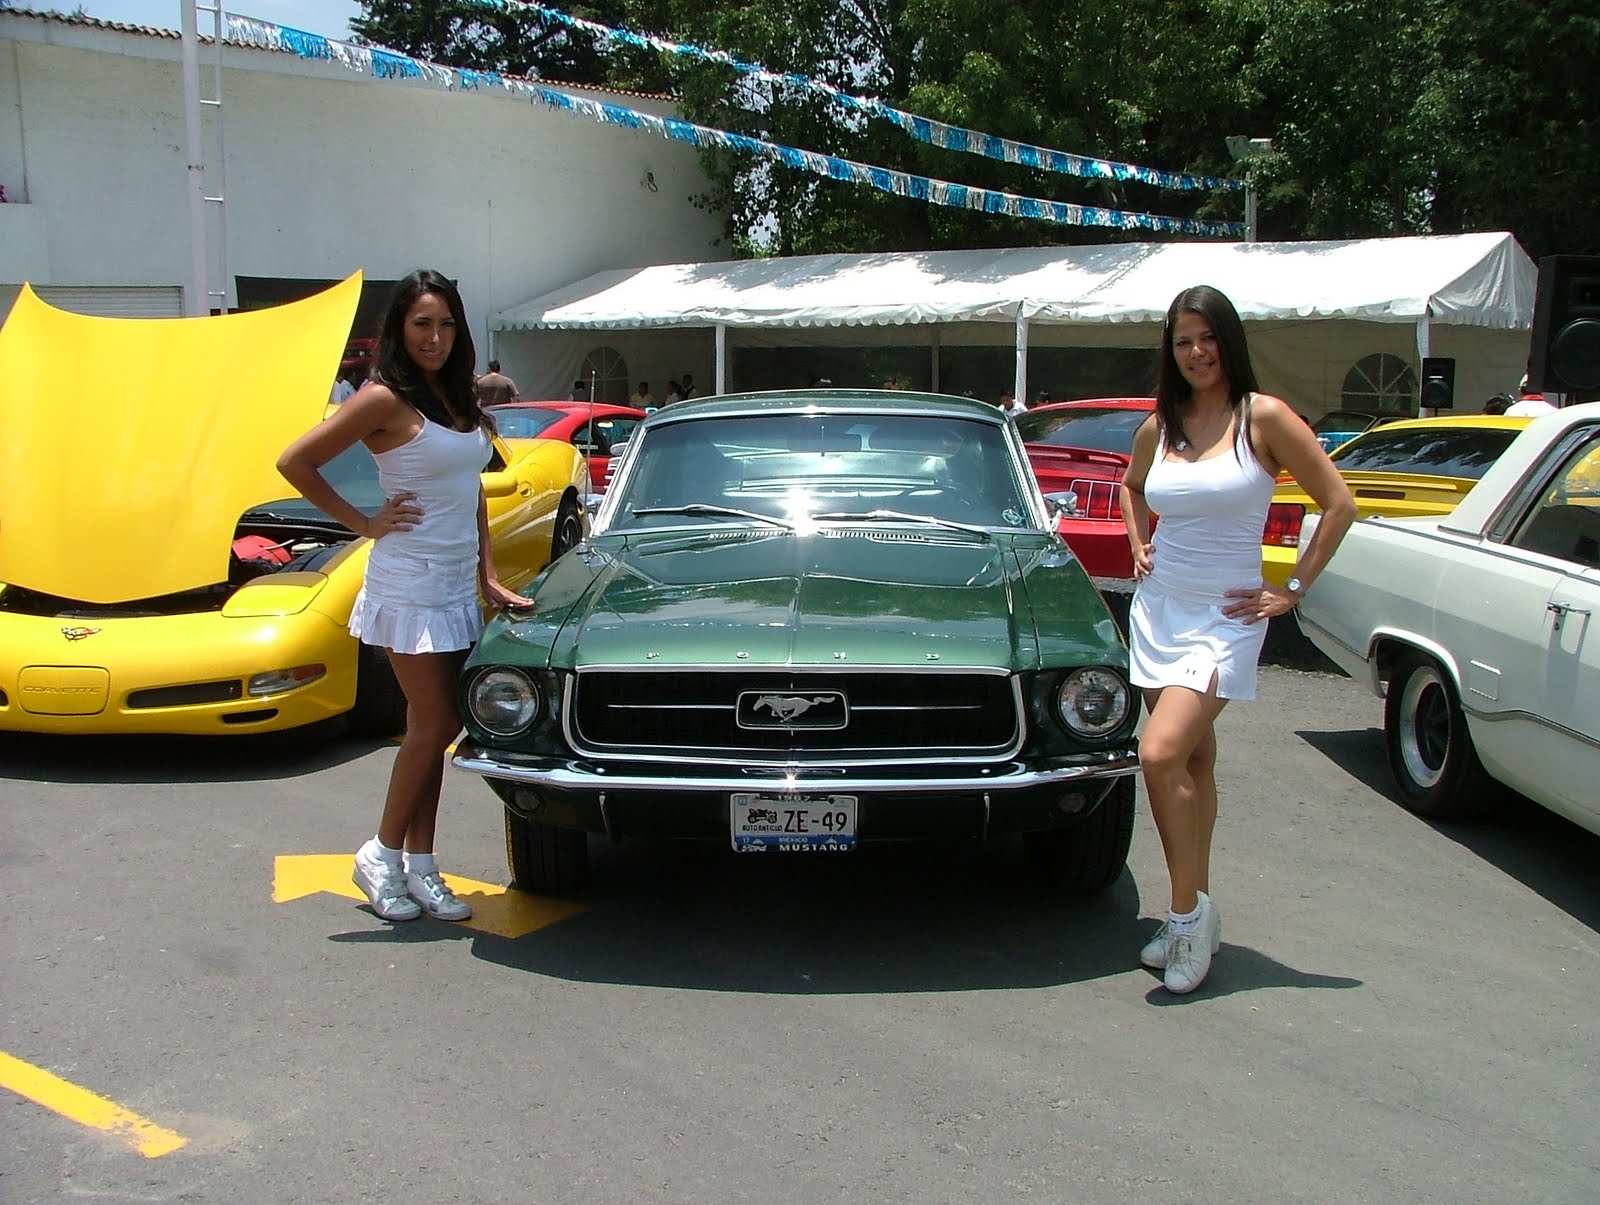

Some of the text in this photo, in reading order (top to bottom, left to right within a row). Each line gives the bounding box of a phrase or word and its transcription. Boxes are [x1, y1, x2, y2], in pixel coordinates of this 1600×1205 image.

[23, 686, 102, 695] CORVETTE
[784, 810, 848, 833] ZE-49
[779, 843, 848, 851] MUSTANG
